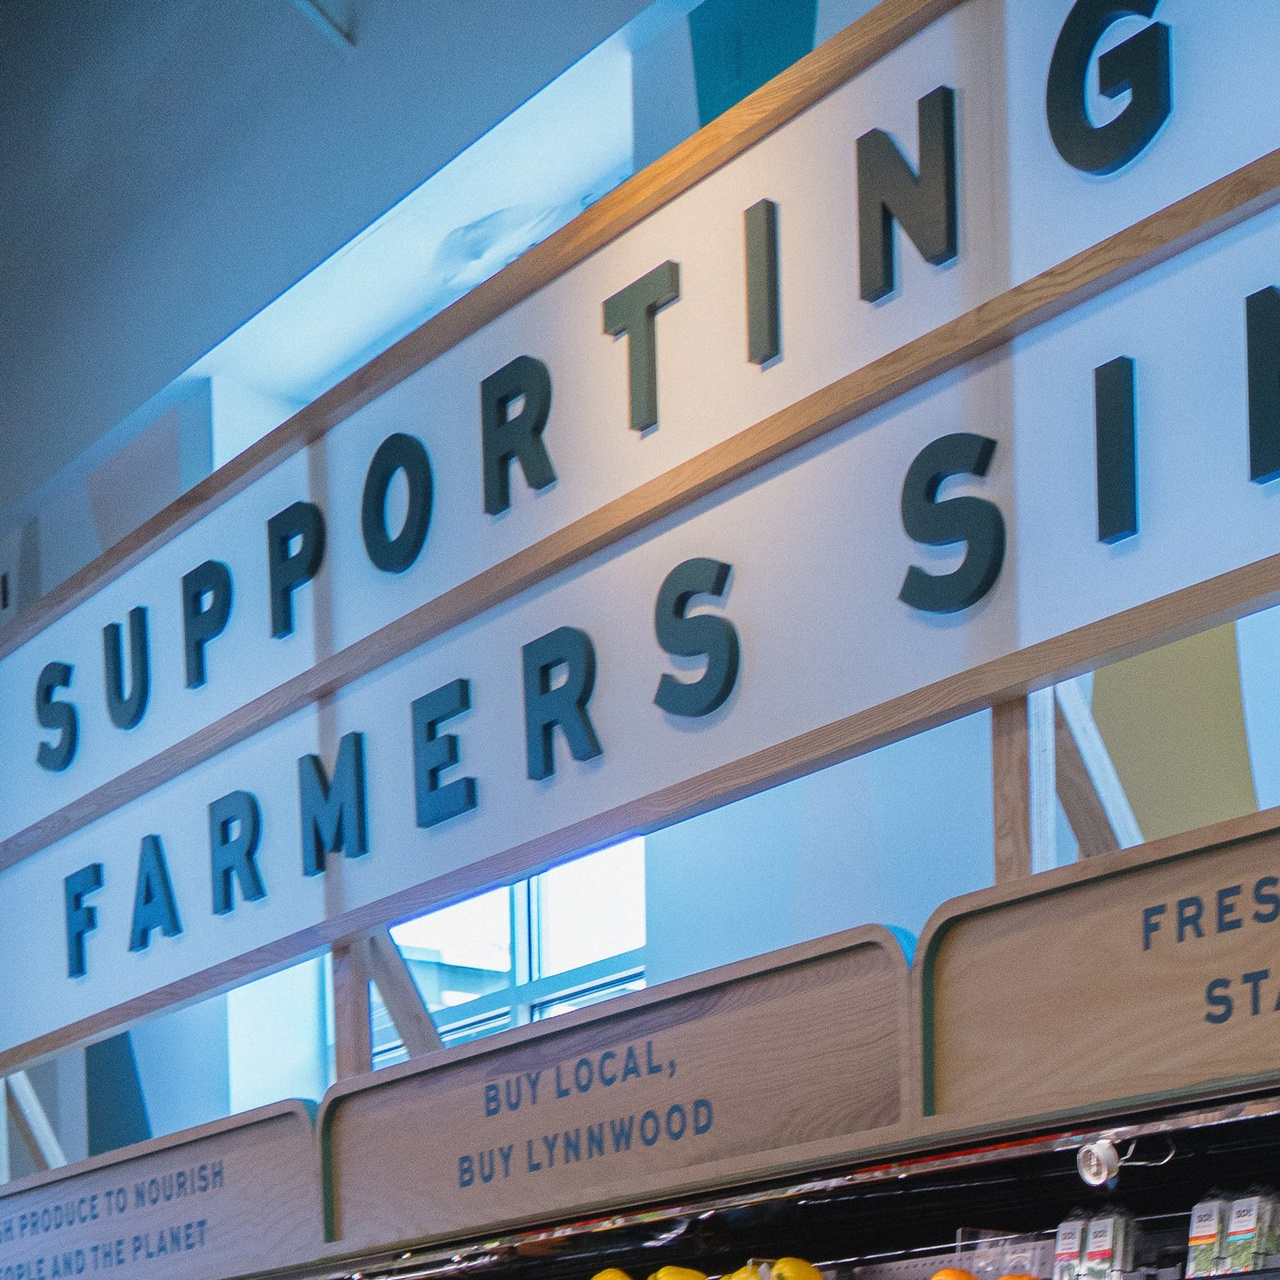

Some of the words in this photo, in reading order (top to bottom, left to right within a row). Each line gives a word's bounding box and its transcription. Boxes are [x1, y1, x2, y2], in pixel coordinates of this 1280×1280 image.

[36, 0, 1174, 773] SUPPORTING
[64, 556, 742, 981] FARMERS
[484, 1070, 542, 1117] BUY
[555, 1040, 676, 1099] LOCAL,
[458, 1144, 514, 1188] BUY
[526, 1098, 714, 1173] LYNNWOOD
[18, 1194, 100, 1239] PRODUCE
[104, 1187, 128, 1216] TO
[133, 1159, 226, 1209] NOURISH
[52, 1248, 86, 1279] AND
[90, 1238, 125, 1271] THE
[132, 1218, 208, 1262] PLANET
